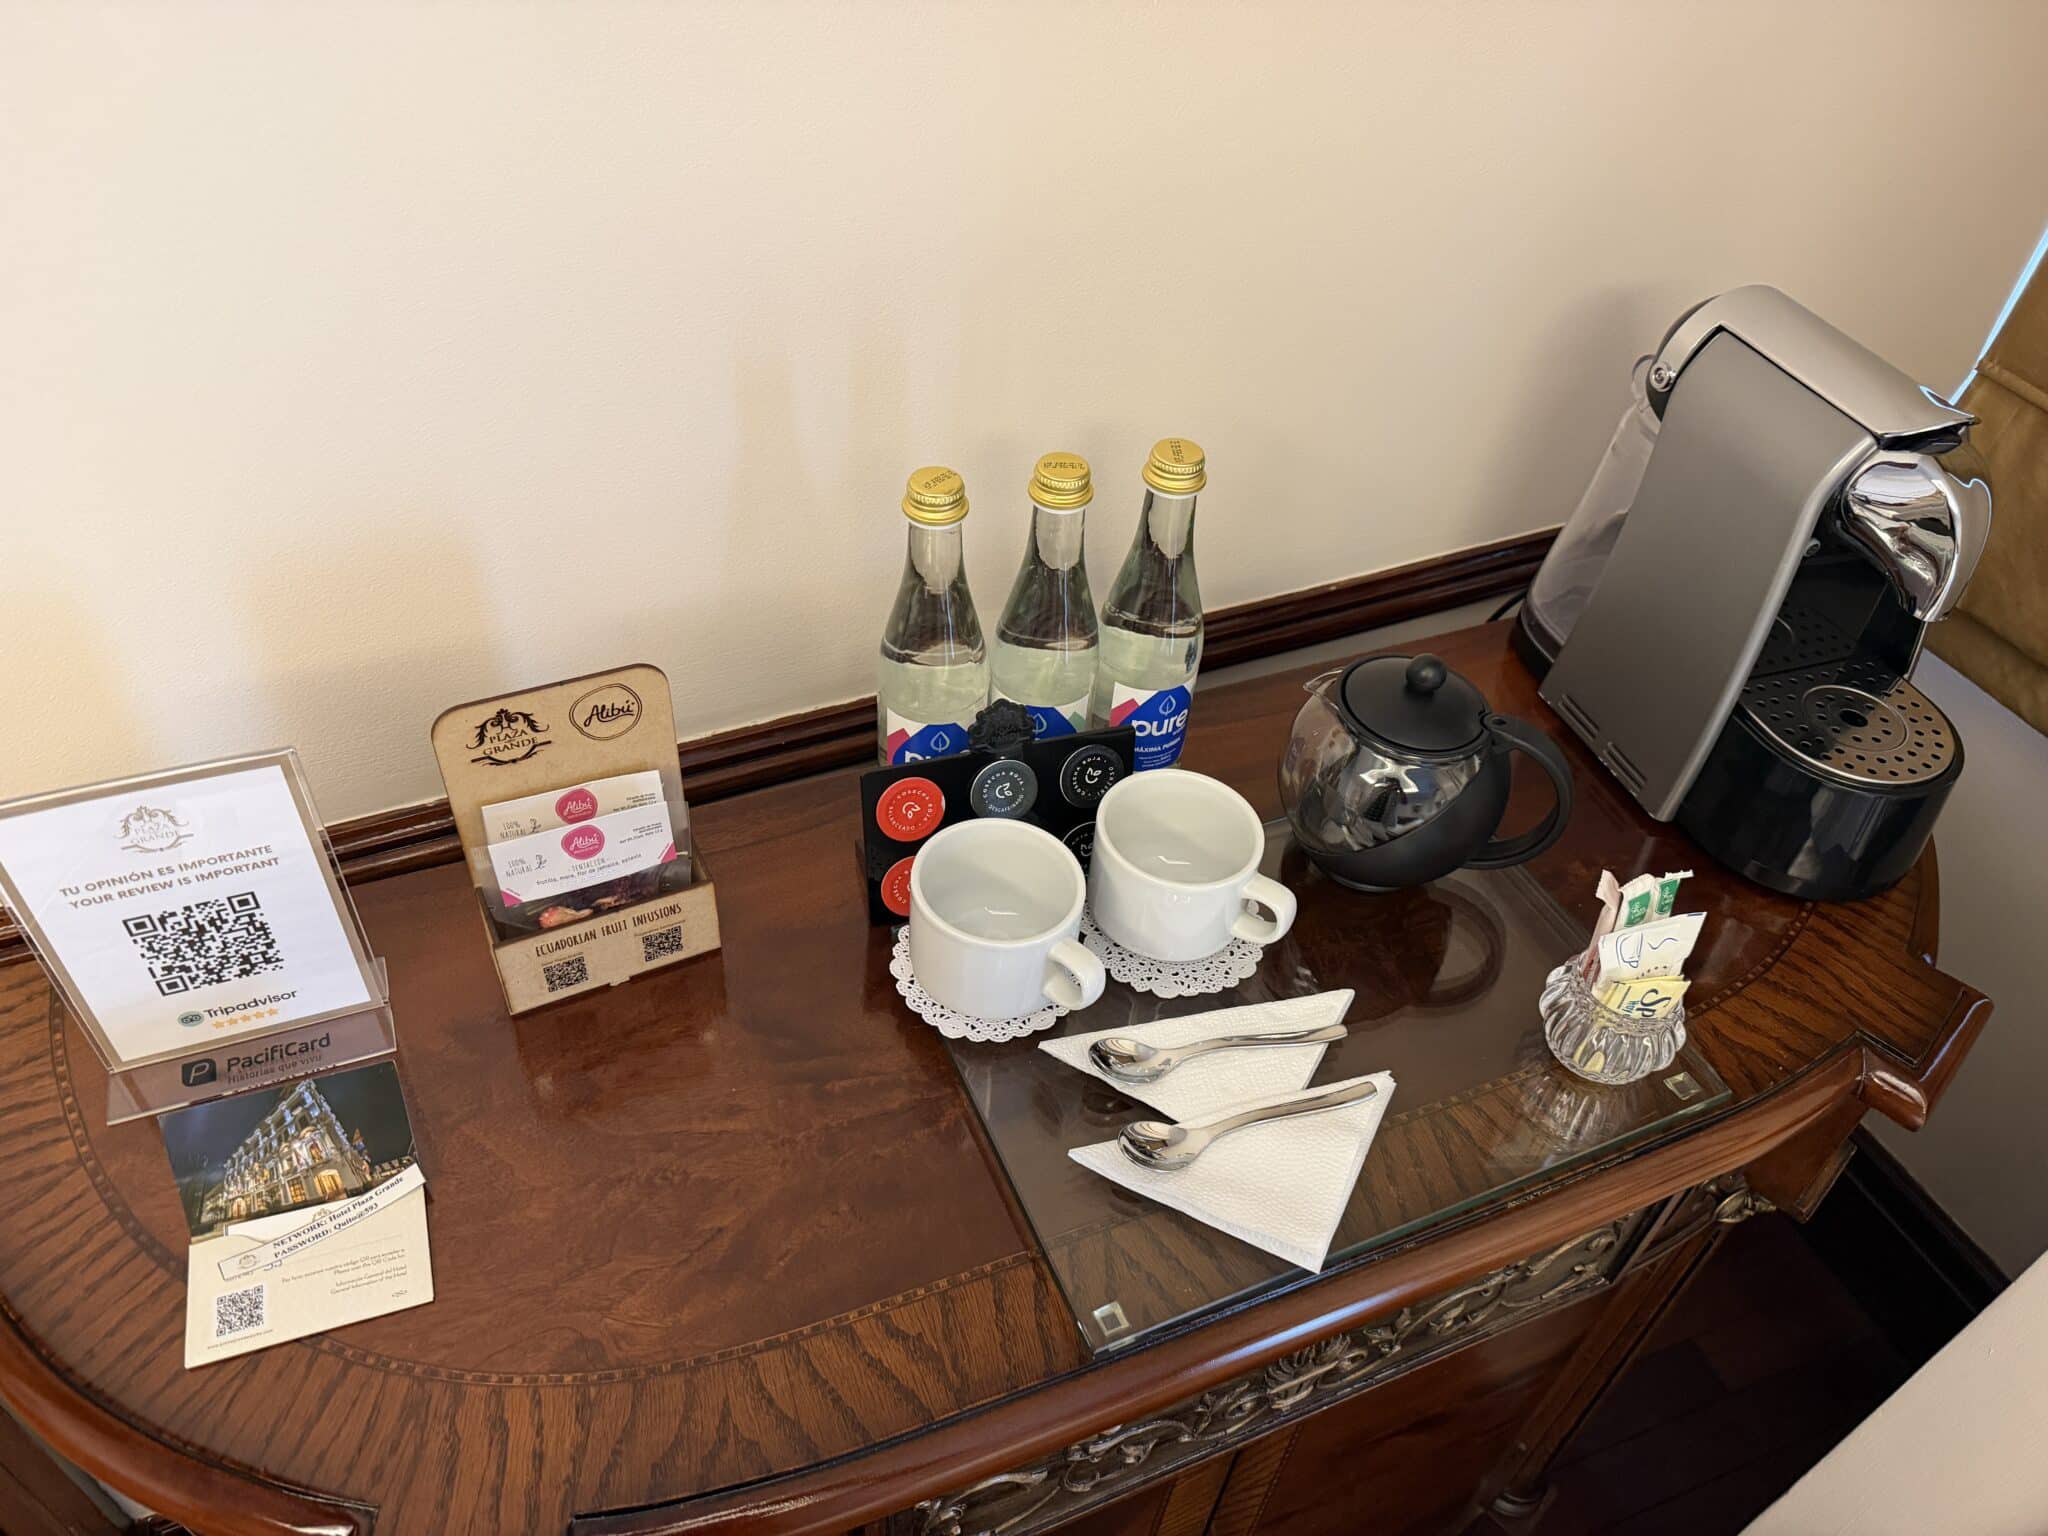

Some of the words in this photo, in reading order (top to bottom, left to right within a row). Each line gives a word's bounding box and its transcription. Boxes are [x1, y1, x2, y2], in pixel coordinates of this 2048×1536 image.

[488, 728, 528, 744] PLAZA
[1131, 709, 1188, 737] pure
[482, 736, 538, 756] GRANDE
[134, 823, 170, 837] PLAZA
[59, 885, 80, 897] TU
[85, 869, 154, 892] OPINIÓN
[157, 865, 175, 876] ES
[178, 845, 273, 872] IMPORTANTE
[69, 893, 114, 909] YOUR
[118, 880, 174, 900] REVIEW
[178, 876, 192, 886] IS
[196, 857, 280, 883] IMPORTANT
[535, 928, 597, 957] ECUADORIAN
[601, 919, 628, 937] FRUIT
[632, 903, 682, 928] INFUSIONS
[204, 990, 298, 1019] Tripadvisor
[227, 1032, 331, 1072] PacifiCard
[227, 1067, 276, 1085] Historias
[278, 1060, 298, 1073] que
[273, 1219, 327, 1249] NETWORK:
[329, 1207, 351, 1223] Hotel
[352, 1195, 374, 1210] Plaza
[374, 1176, 404, 1197] Grande
[274, 1229, 333, 1259] PASSWORD:
